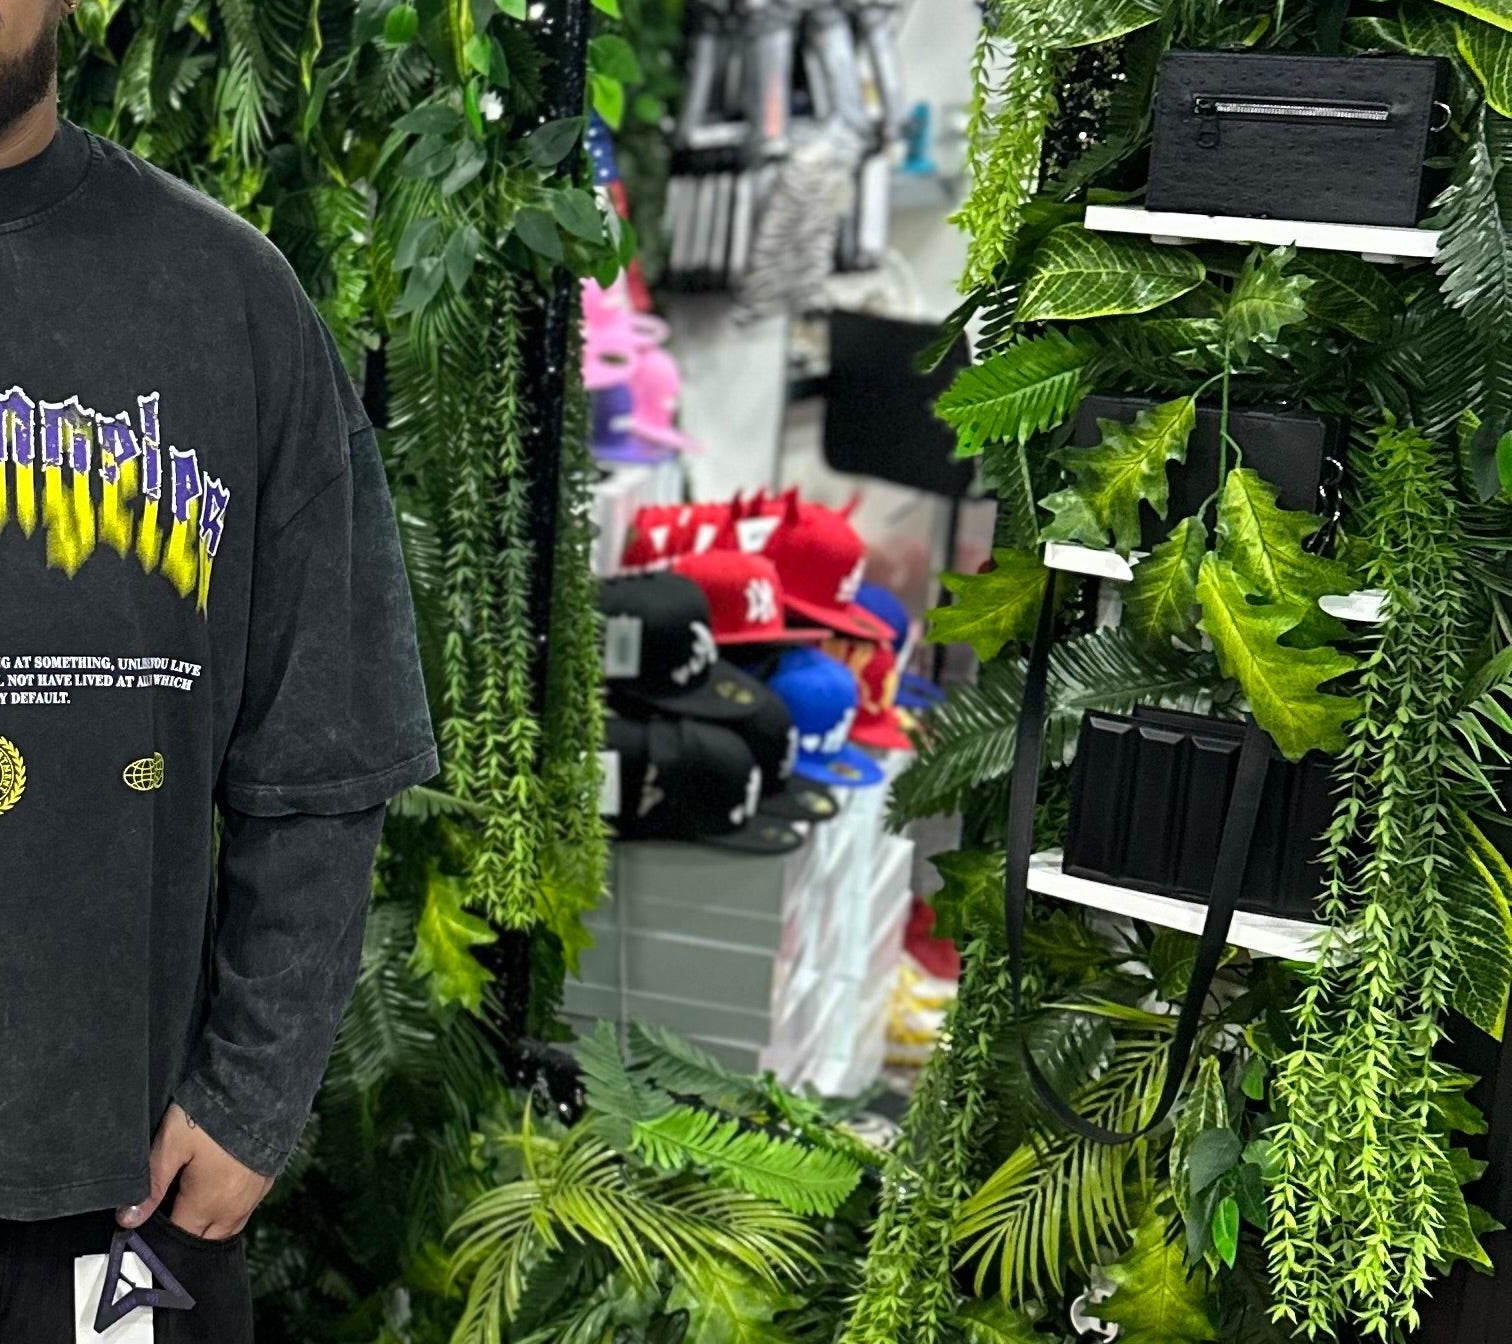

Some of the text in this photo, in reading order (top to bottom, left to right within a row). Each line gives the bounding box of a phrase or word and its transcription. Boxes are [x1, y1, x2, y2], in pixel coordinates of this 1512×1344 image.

[13, 655, 31, 669] AT
[34, 656, 116, 671] SOMETHING,
[170, 660, 202, 677] LIVE
[7, 674, 35, 687] NOT
[37, 674, 73, 687] HAVE
[74, 674, 114, 687] LIVED
[115, 674, 135, 688] AT
[153, 673, 194, 691] WHICH
[10, 691, 71, 705] DEFAULT.
